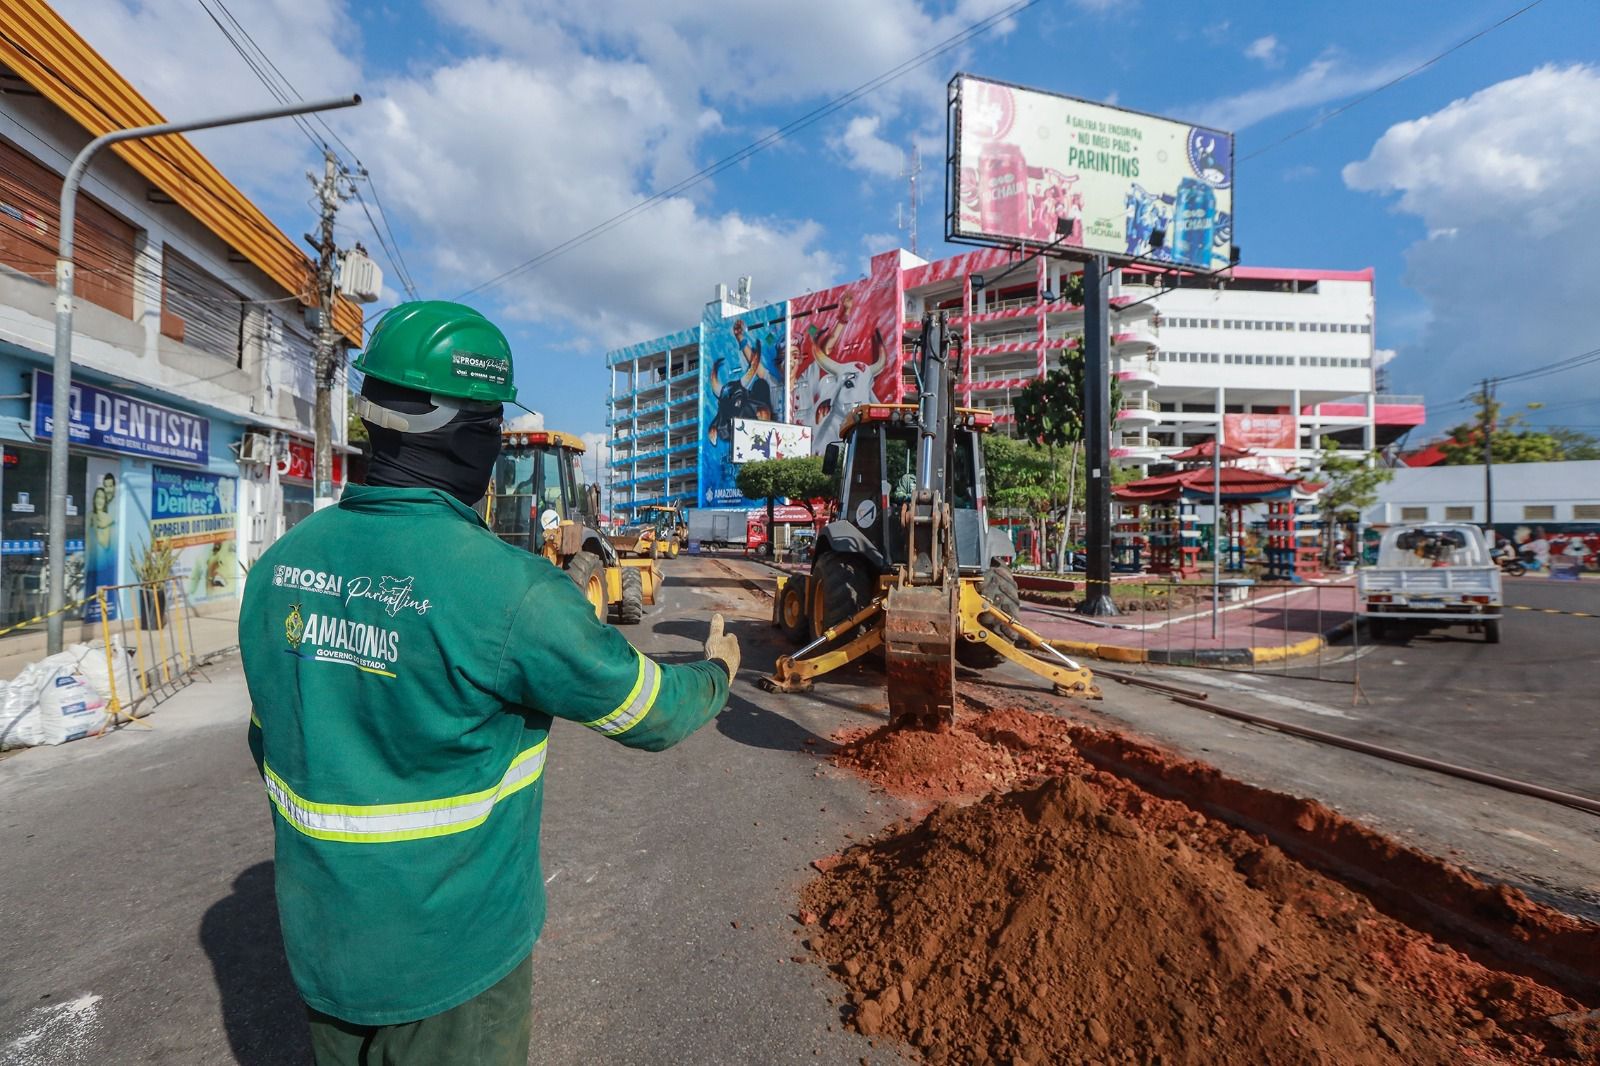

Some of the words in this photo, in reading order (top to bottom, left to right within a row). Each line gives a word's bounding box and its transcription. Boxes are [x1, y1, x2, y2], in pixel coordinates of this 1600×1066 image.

[1077, 132, 1090, 145] NO
[1092, 133, 1111, 149] MEU
[1068, 146, 1140, 178] PARINTINS
[460, 356, 486, 368] PROSAI
[93, 392, 203, 452] DENTISTA
[153, 466, 182, 483] Vamos
[183, 475, 215, 494] cuidar
[157, 487, 217, 514] Dentes?
[154, 520, 190, 537] APARELHO
[283, 565, 343, 593] PROSAI
[301, 613, 399, 663] AMAZONAS
[316, 648, 352, 660] GOVERNO
[360, 658, 386, 670] ESTADO
